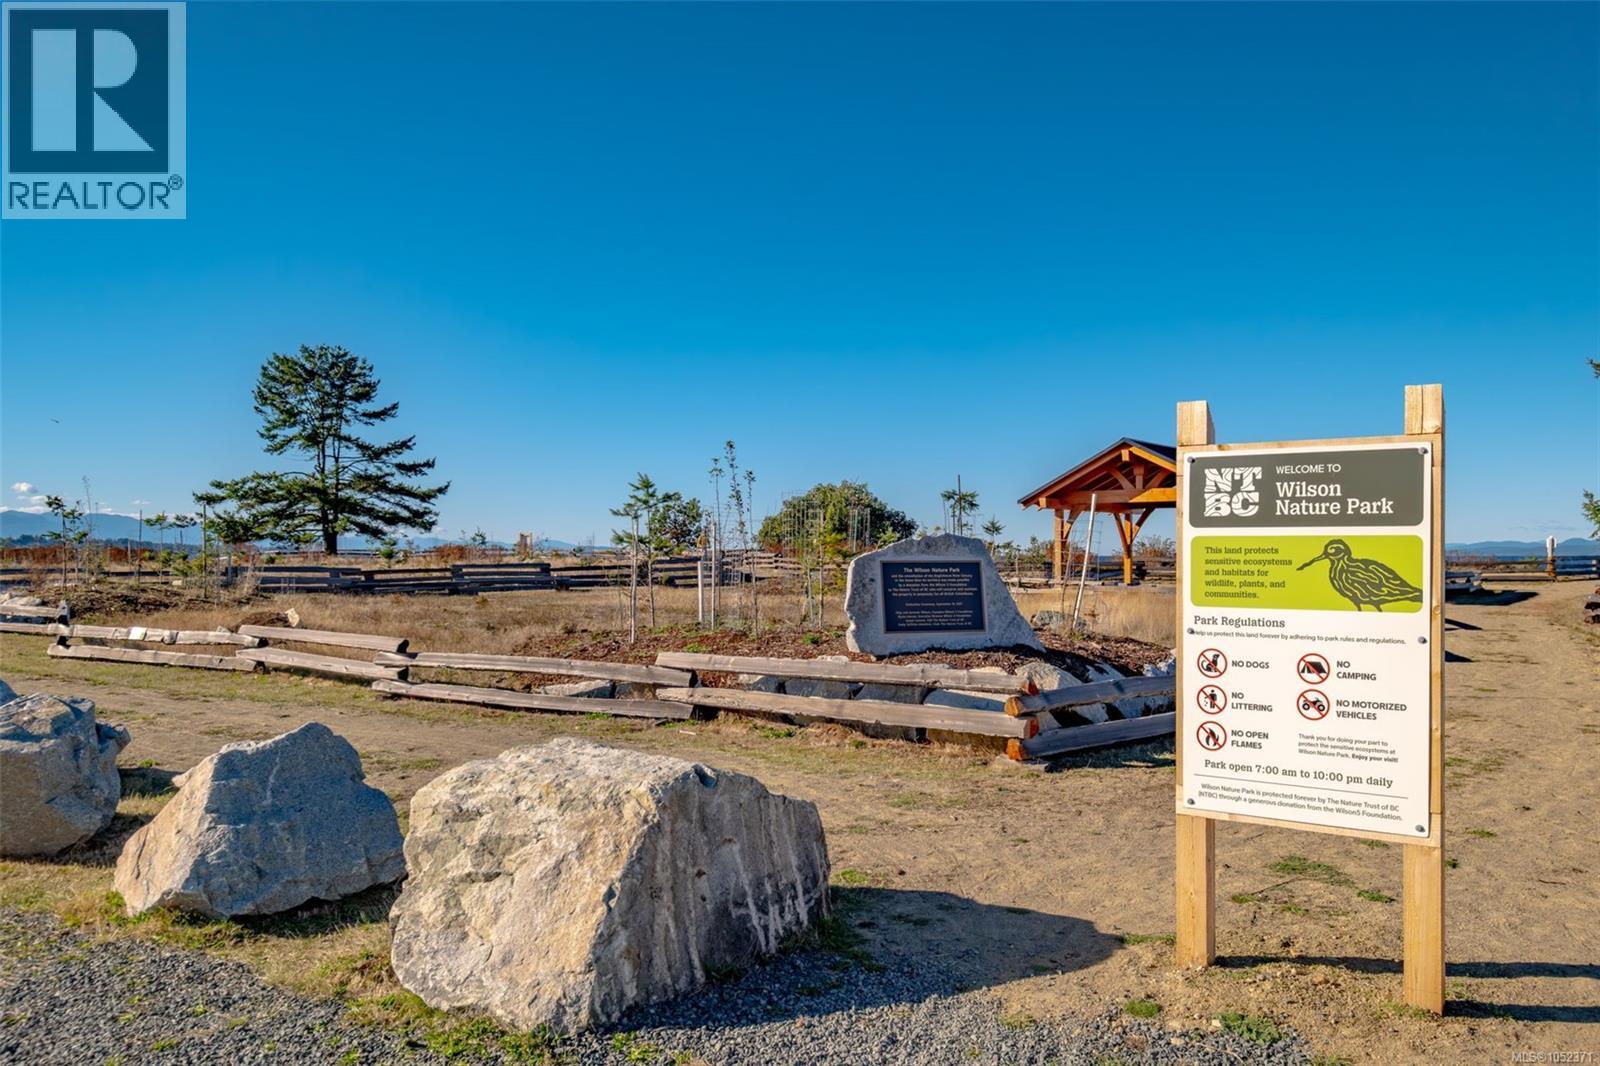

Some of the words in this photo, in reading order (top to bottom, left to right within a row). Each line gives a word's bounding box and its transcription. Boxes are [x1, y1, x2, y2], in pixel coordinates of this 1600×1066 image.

[1276, 465, 1324, 474] WELCOME
[1327, 464, 1342, 473] TO
[1204, 466, 1262, 492] NT
[1276, 482, 1342, 498] Wilson
[1204, 492, 1259, 517] BC
[1275, 499, 1341, 516] Nature
[1347, 498, 1394, 514] Park
[1244, 546, 1279, 556] protects
[1244, 558, 1292, 566] ecosystems
[1204, 580, 1237, 588] wildlife,
[1239, 580, 1268, 588] plants,
[1194, 615, 1218, 626] Park
[1221, 616, 1286, 628] Regulations
[1232, 660, 1244, 668] NO
[1246, 661, 1270, 669] DOGS
[1336, 660, 1350, 668] NO
[1336, 672, 1376, 681] CAMPING
[1232, 702, 1273, 712] LITTERING
[1352, 700, 1408, 712] MOTORIZED
[1336, 710, 1377, 720] VEHICLES
[1231, 730, 1244, 738] NO
[1245, 730, 1269, 740] OPEN
[1231, 740, 1262, 750] FLAMES
[1355, 746, 1388, 754] ecosystems
[1352, 753, 1368, 761] Enjoy
[1204, 759, 1226, 770] Park
[1228, 762, 1252, 772] open
[1255, 764, 1279, 775] 7:00
[1282, 768, 1297, 777] am
[1300, 769, 1310, 778] to
[1313, 770, 1344, 782] 10:00
[1346, 775, 1363, 784] pm
[1366, 776, 1394, 788] daily
[1198, 790, 1218, 798] (NTBC)
[1218, 793, 1242, 802] through
[1248, 797, 1276, 806] generous
[1277, 800, 1306, 809] donation
[1307, 803, 1322, 811] from
[1336, 807, 1360, 816] Wilson5
[1362, 810, 1402, 820] Foundation.
[1262, 790, 1293, 800] protected
[1294, 794, 1316, 802] forever
[1318, 796, 1326, 804] by
[1340, 799, 1362, 808] Nature
[1364, 802, 1380, 810] Trust
